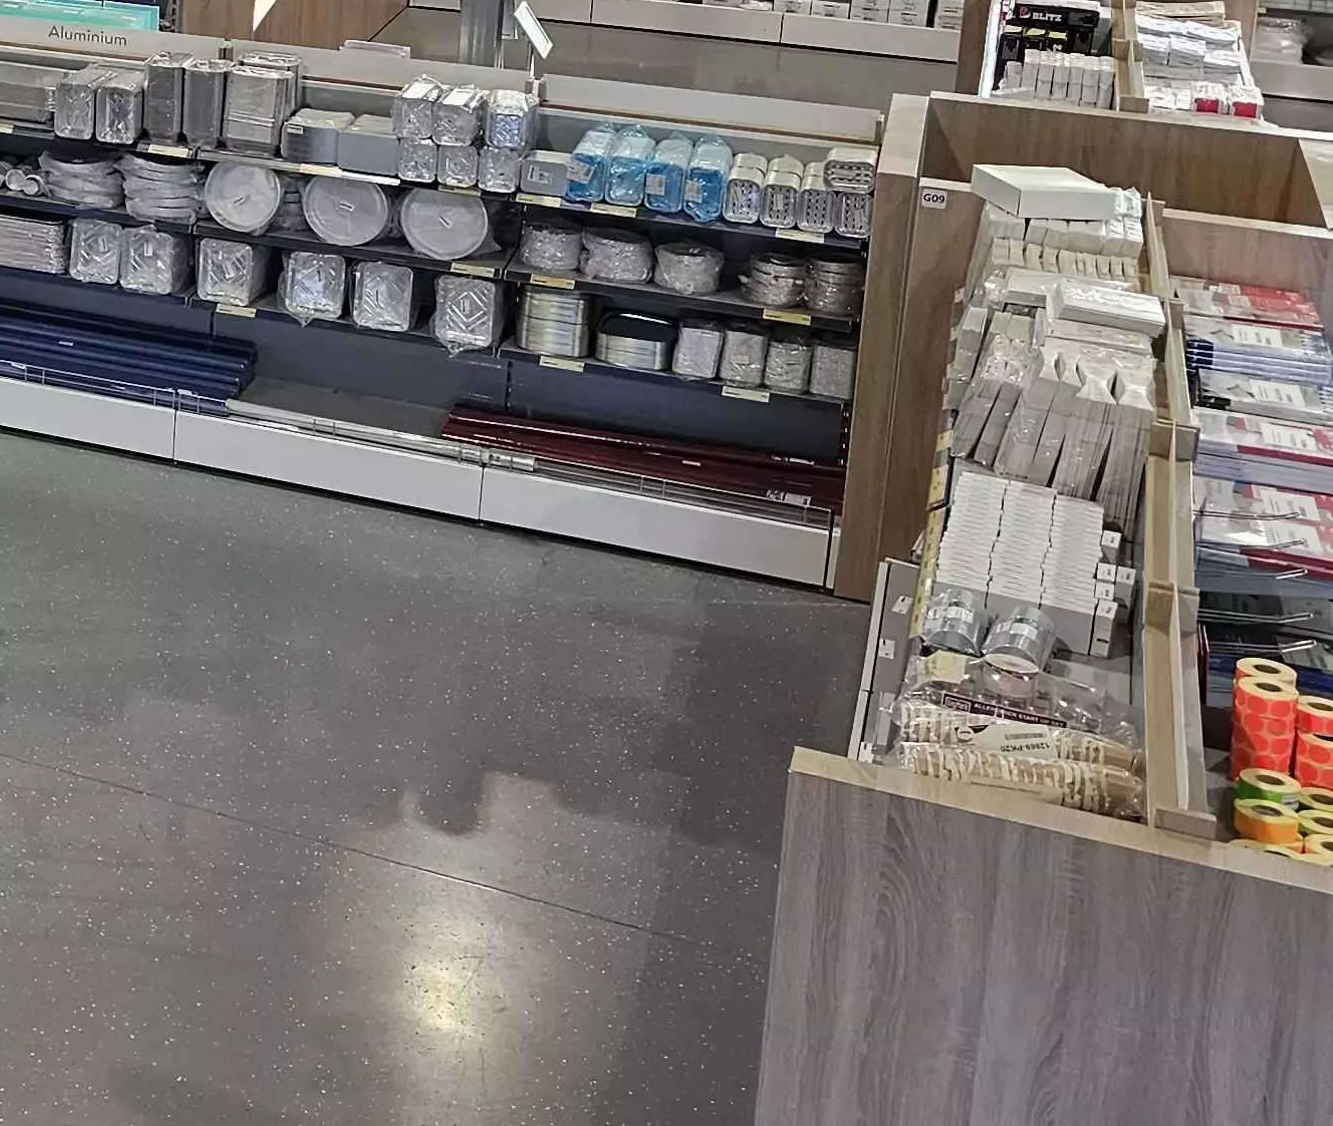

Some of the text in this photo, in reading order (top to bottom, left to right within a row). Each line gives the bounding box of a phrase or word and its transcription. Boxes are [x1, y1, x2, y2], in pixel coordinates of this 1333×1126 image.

[1032, 11, 1062, 22] BLITZ
[48, 24, 127, 46] Aluminium
[922, 192, 946, 205] G09
